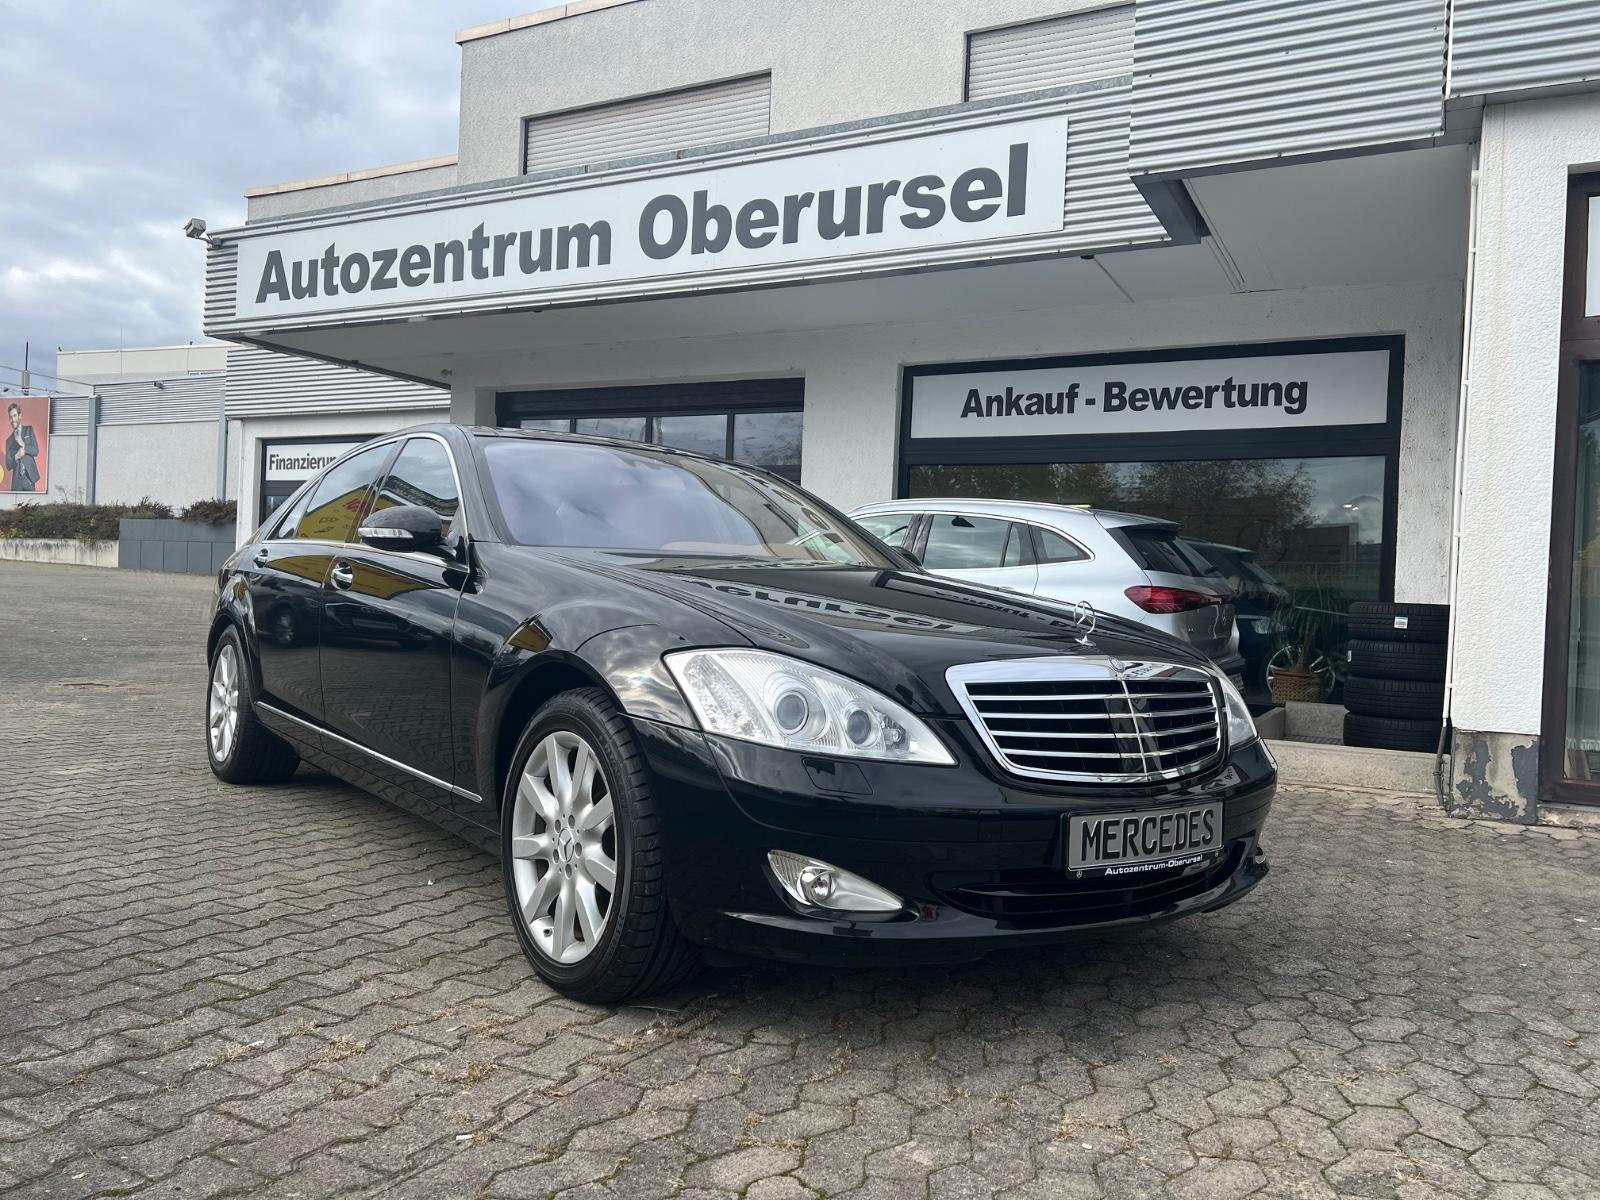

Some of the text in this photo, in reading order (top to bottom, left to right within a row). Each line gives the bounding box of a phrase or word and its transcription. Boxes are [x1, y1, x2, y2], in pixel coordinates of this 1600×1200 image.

[255, 142, 1029, 303] Autozentrum Oberursel
[960, 383, 1080, 418] Ankauf
[1103, 376, 1307, 415] Bewertung
[1081, 809, 1214, 861] MERCEDES
